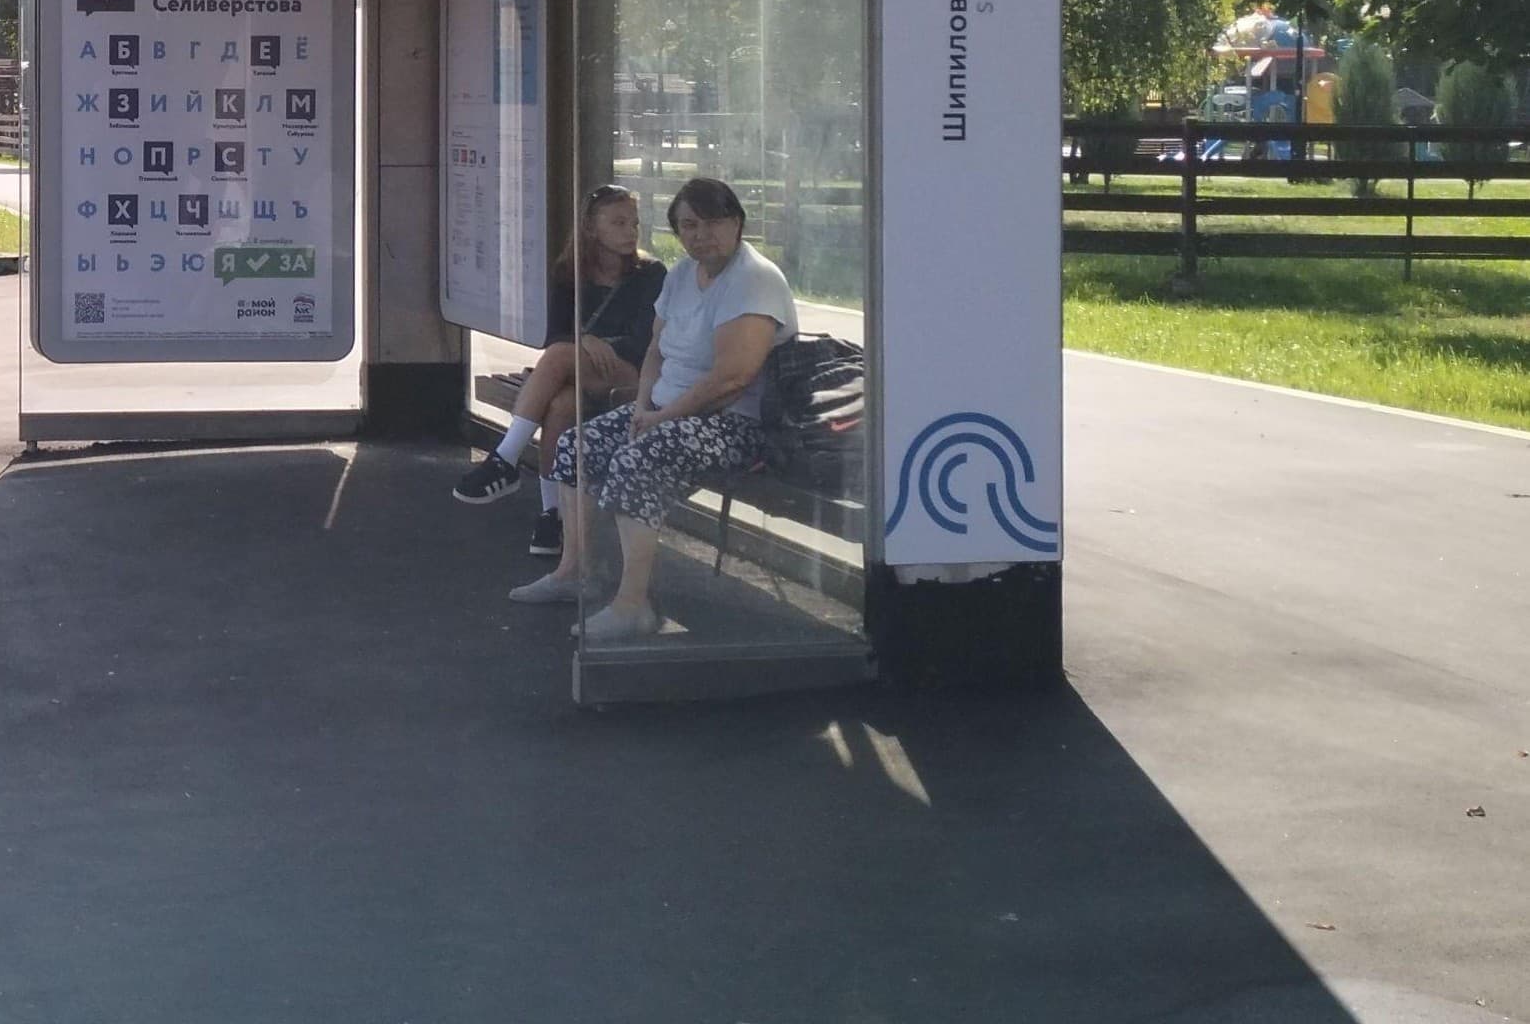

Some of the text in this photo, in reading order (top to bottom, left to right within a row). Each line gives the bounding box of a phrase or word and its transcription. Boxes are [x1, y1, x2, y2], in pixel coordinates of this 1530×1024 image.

[80, 36, 309, 63] А Б В Г Д Е Ё
[76, 89, 311, 113] Ж З И Й К Л М
[79, 146, 309, 166] Н О П Р С Т У
[77, 199, 309, 222] Ф Х Ц Ч Ш Щ Ъ
[77, 253, 308, 273] Ы Ь Э Ю Я ЗА
